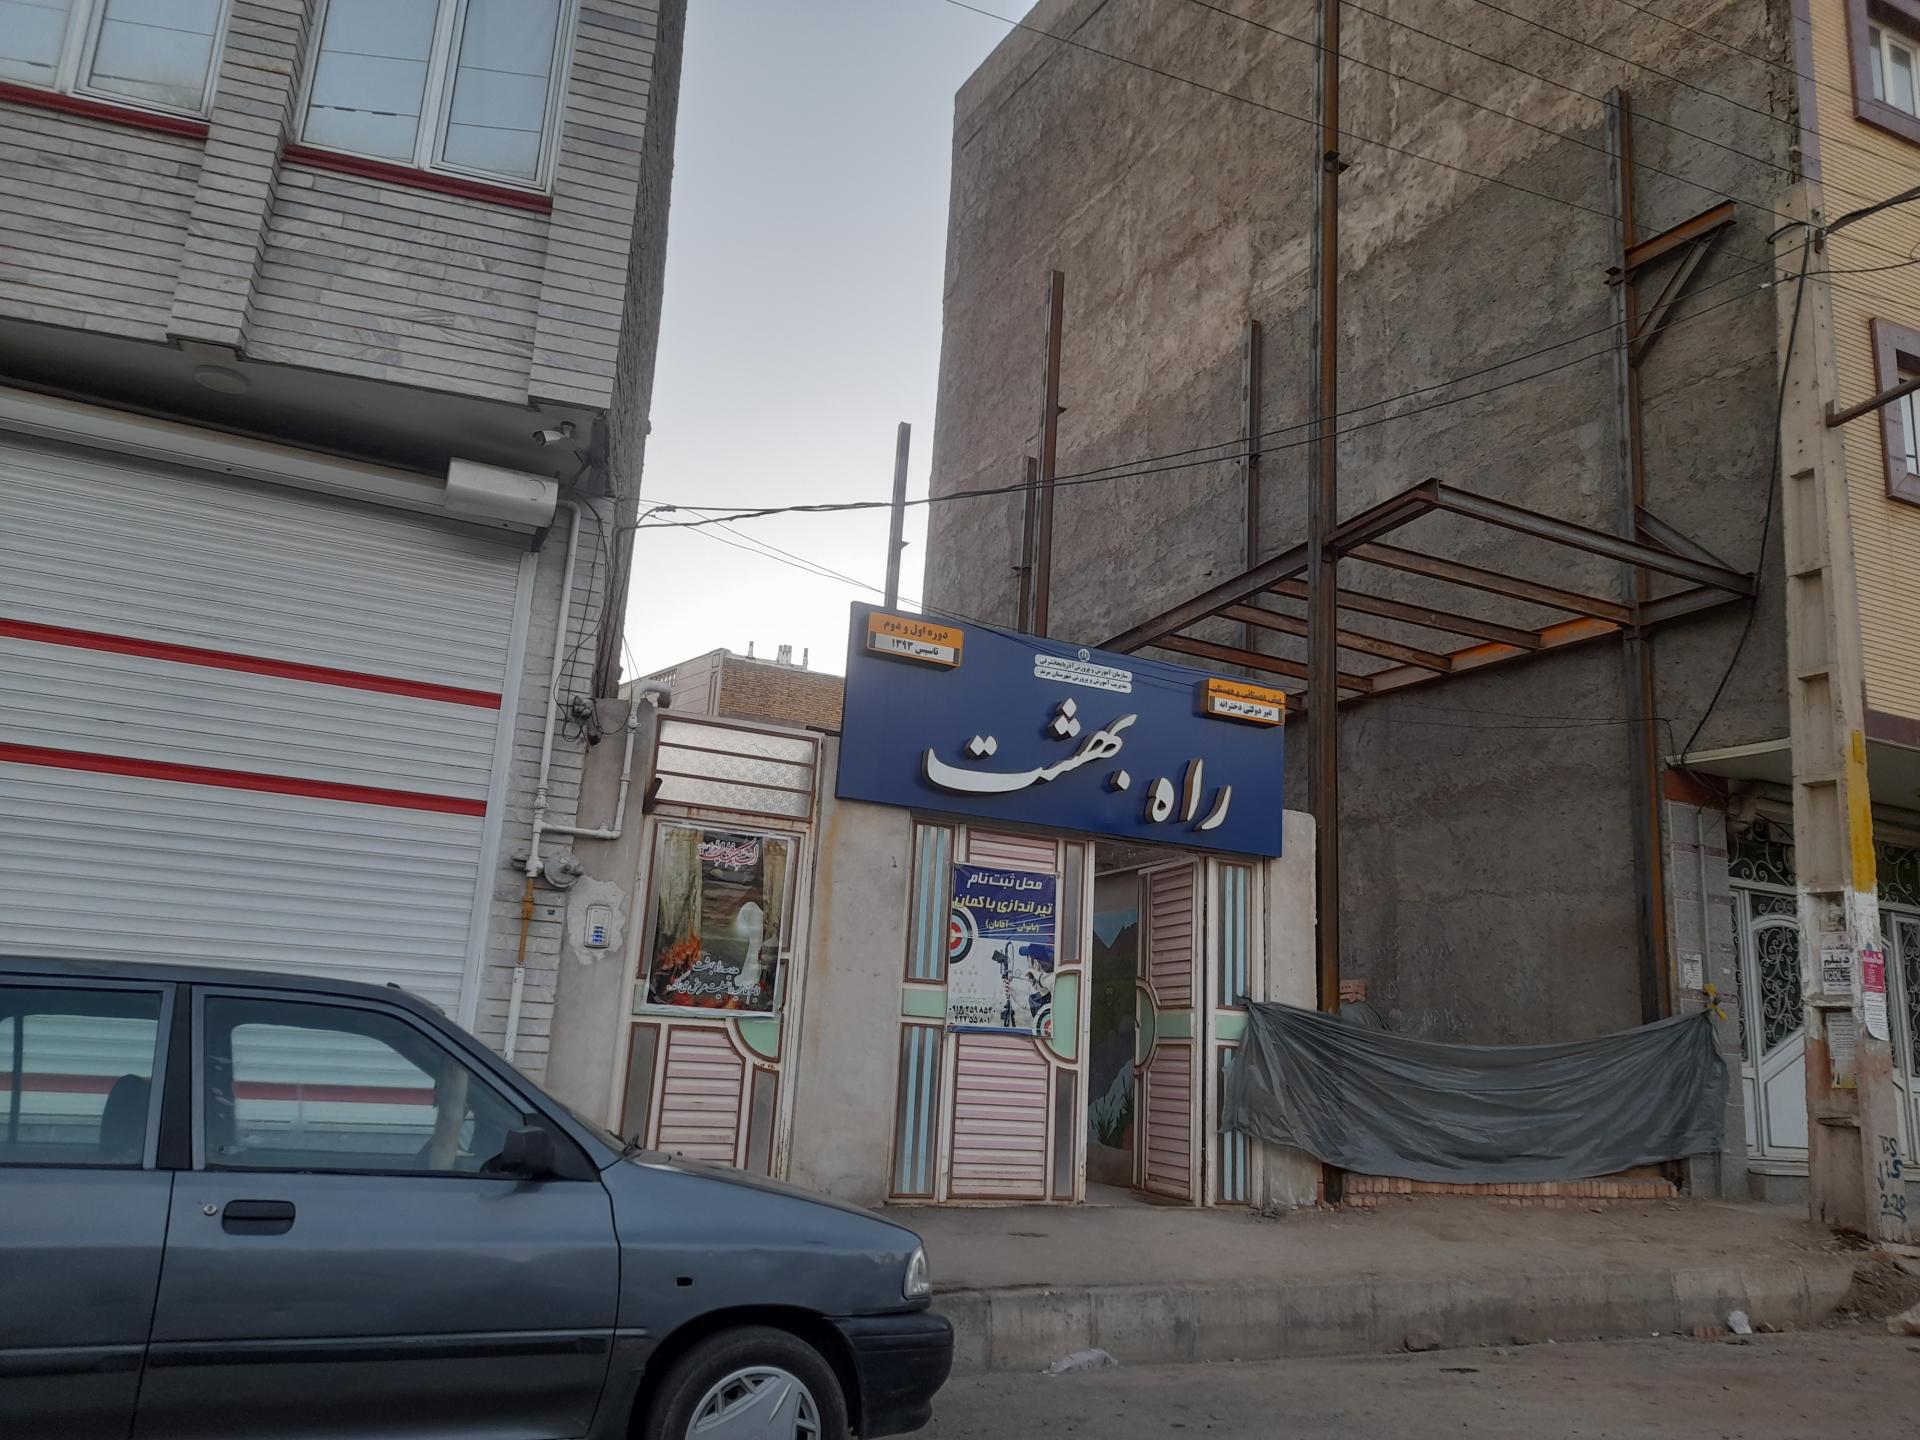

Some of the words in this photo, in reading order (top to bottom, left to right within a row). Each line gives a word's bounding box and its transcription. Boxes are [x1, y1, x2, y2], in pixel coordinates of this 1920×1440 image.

[883, 620, 901, 632] دوم
[909, 623, 926, 637] اول
[927, 629, 949, 641] دوره
[891, 639, 914, 651] ۱۳۹۳
[914, 646, 939, 656] تاسیس
[1219, 699, 1242, 712] دخترانه
[1242, 705, 1262, 716] دولتی
[1262, 709, 1273, 718] غیر
[921, 696, 1138, 794] بهشت
[1146, 758, 1232, 832] راه
[966, 872, 989, 889] نام
[988, 873, 1016, 890] ثبت
[1015, 877, 1043, 890] محل
[952, 893, 985, 908] کمان
[985, 896, 996, 912] با
[996, 899, 1035, 913] اندازی
[1034, 902, 1054, 917] تیر
